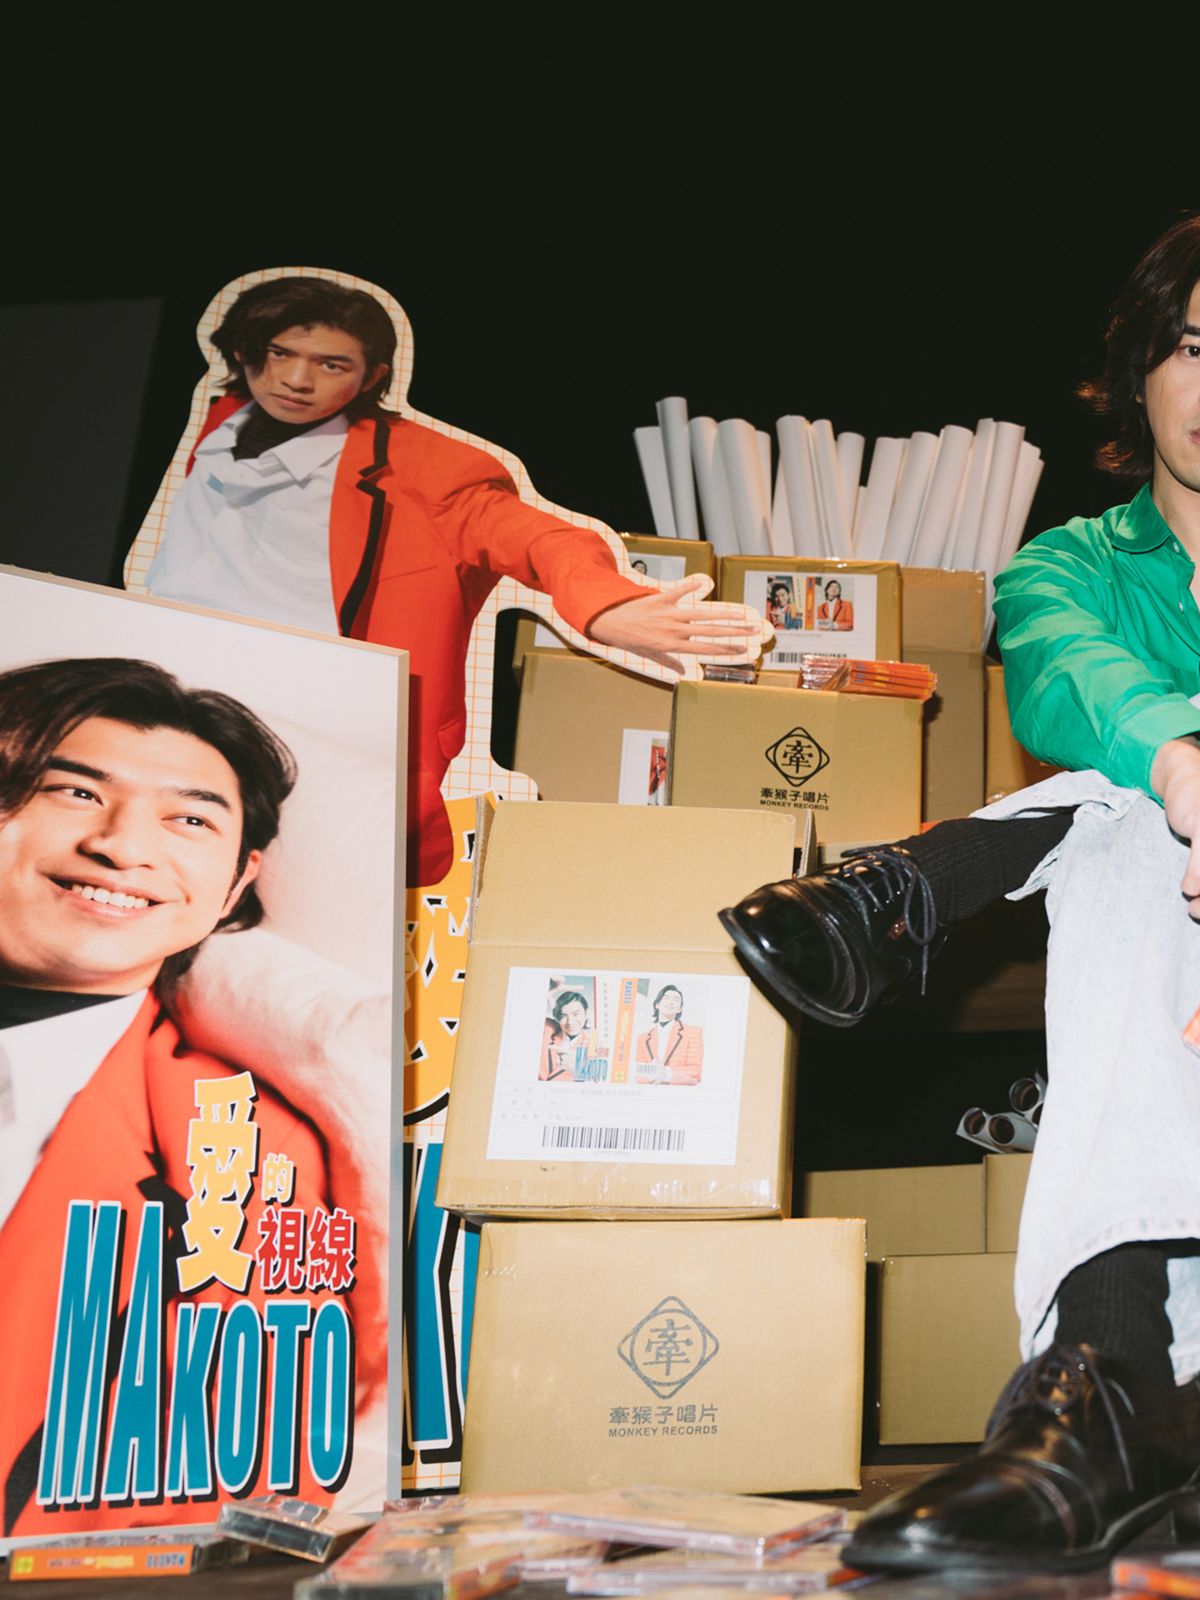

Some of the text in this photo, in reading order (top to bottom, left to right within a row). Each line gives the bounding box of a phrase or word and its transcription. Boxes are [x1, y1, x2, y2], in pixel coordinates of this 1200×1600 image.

[781, 740, 813, 774] 牽
[760, 787, 829, 804] 牽猴子唱片
[760, 799, 829, 811] MONKEY RECORDS
[36, 1200, 353, 1508] MAKOTO
[643, 1319, 693, 1376] 牽
[609, 1404, 718, 1425] 牽猴子唱片
[608, 1425, 718, 1438] MONKEY RECORDS
